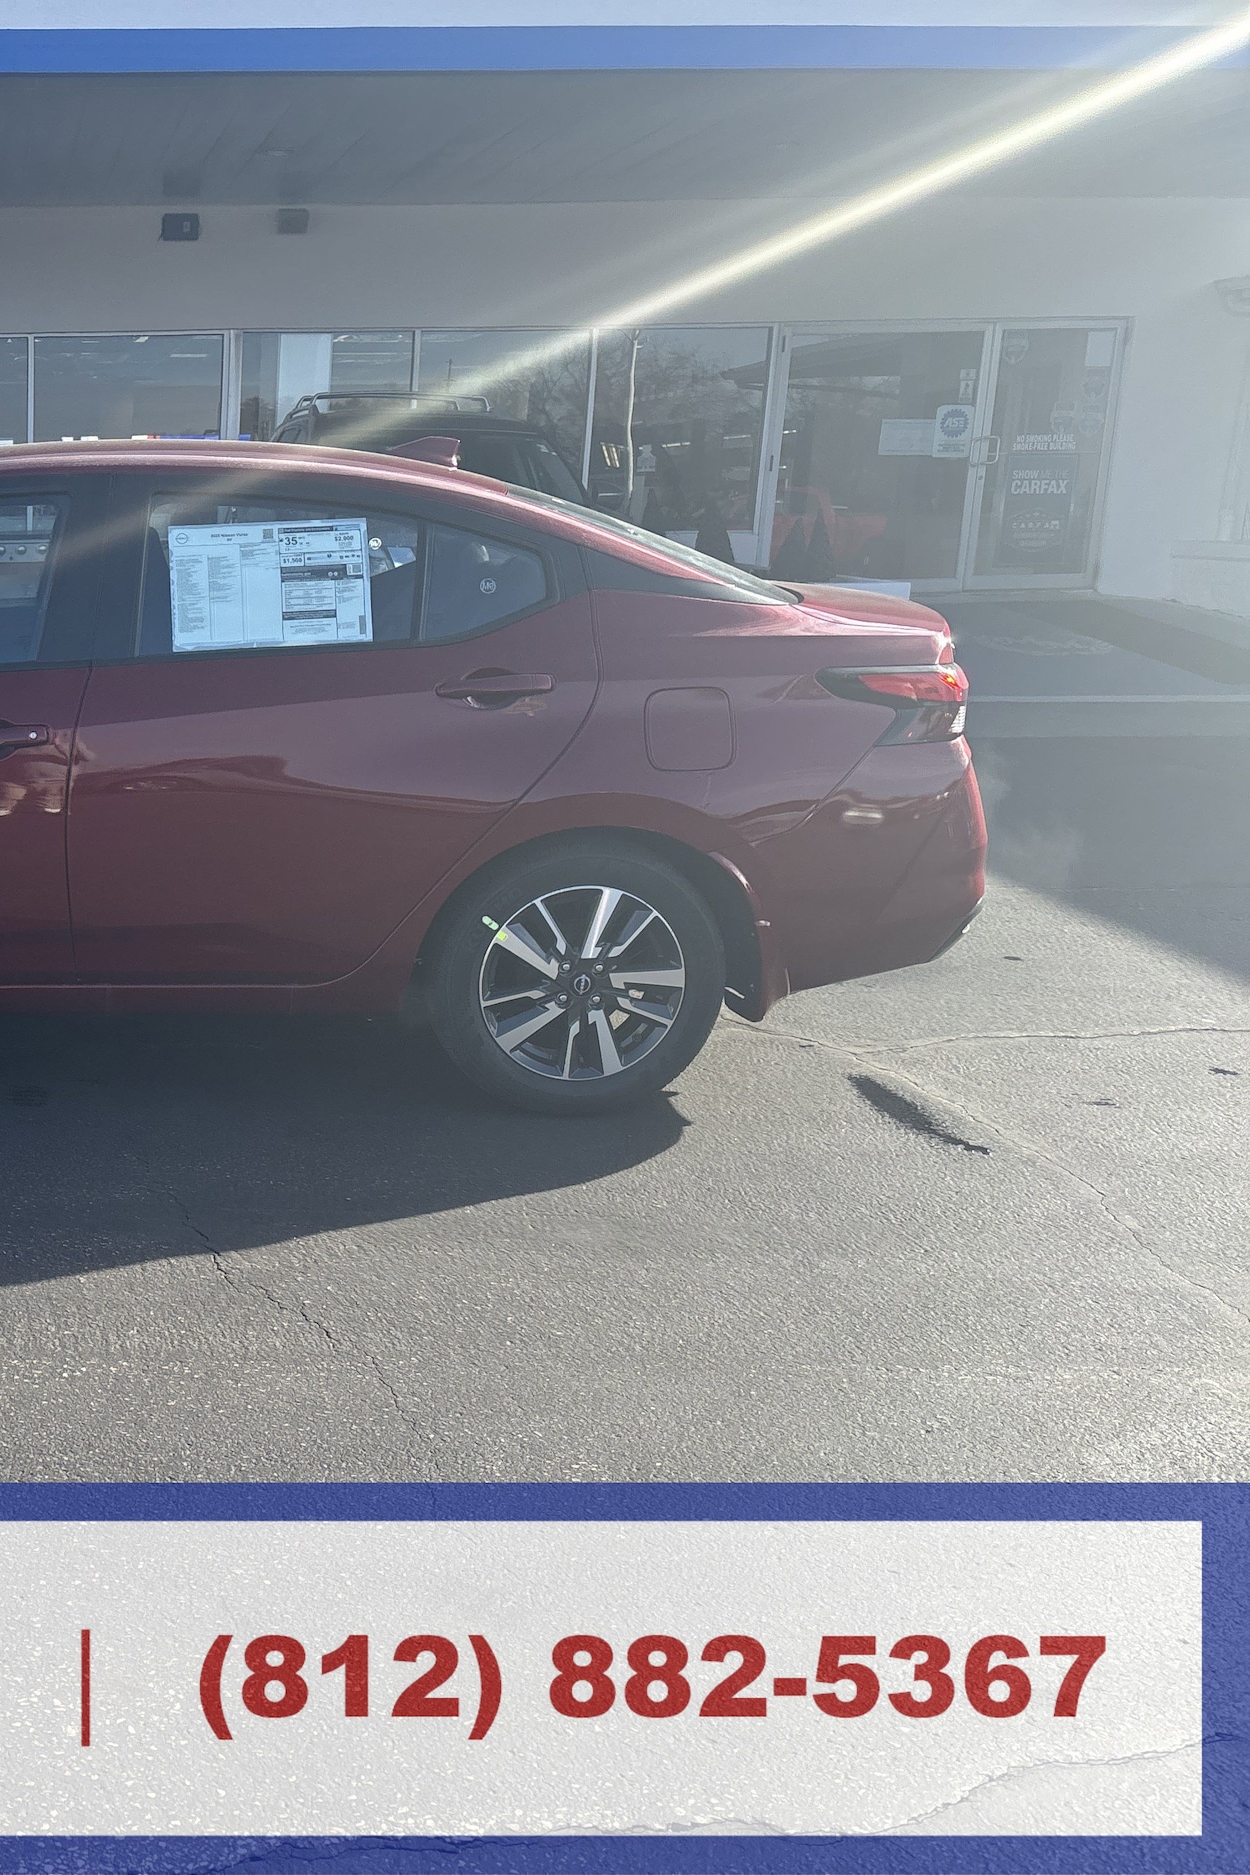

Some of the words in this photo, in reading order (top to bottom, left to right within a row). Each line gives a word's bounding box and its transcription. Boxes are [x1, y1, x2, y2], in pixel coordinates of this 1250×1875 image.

[944, 418, 964, 428] ASE
[1026, 434, 1052, 442] SMOKING
[1013, 442, 1048, 450] SMOKE-FREE
[1050, 442, 1076, 450] BUILDING
[1013, 470, 1038, 479] SHOW
[1040, 470, 1052, 479] ME
[1055, 470, 1069, 479] THE
[1011, 479, 1069, 495] CARFAX
[284, 536, 298, 546] 35
